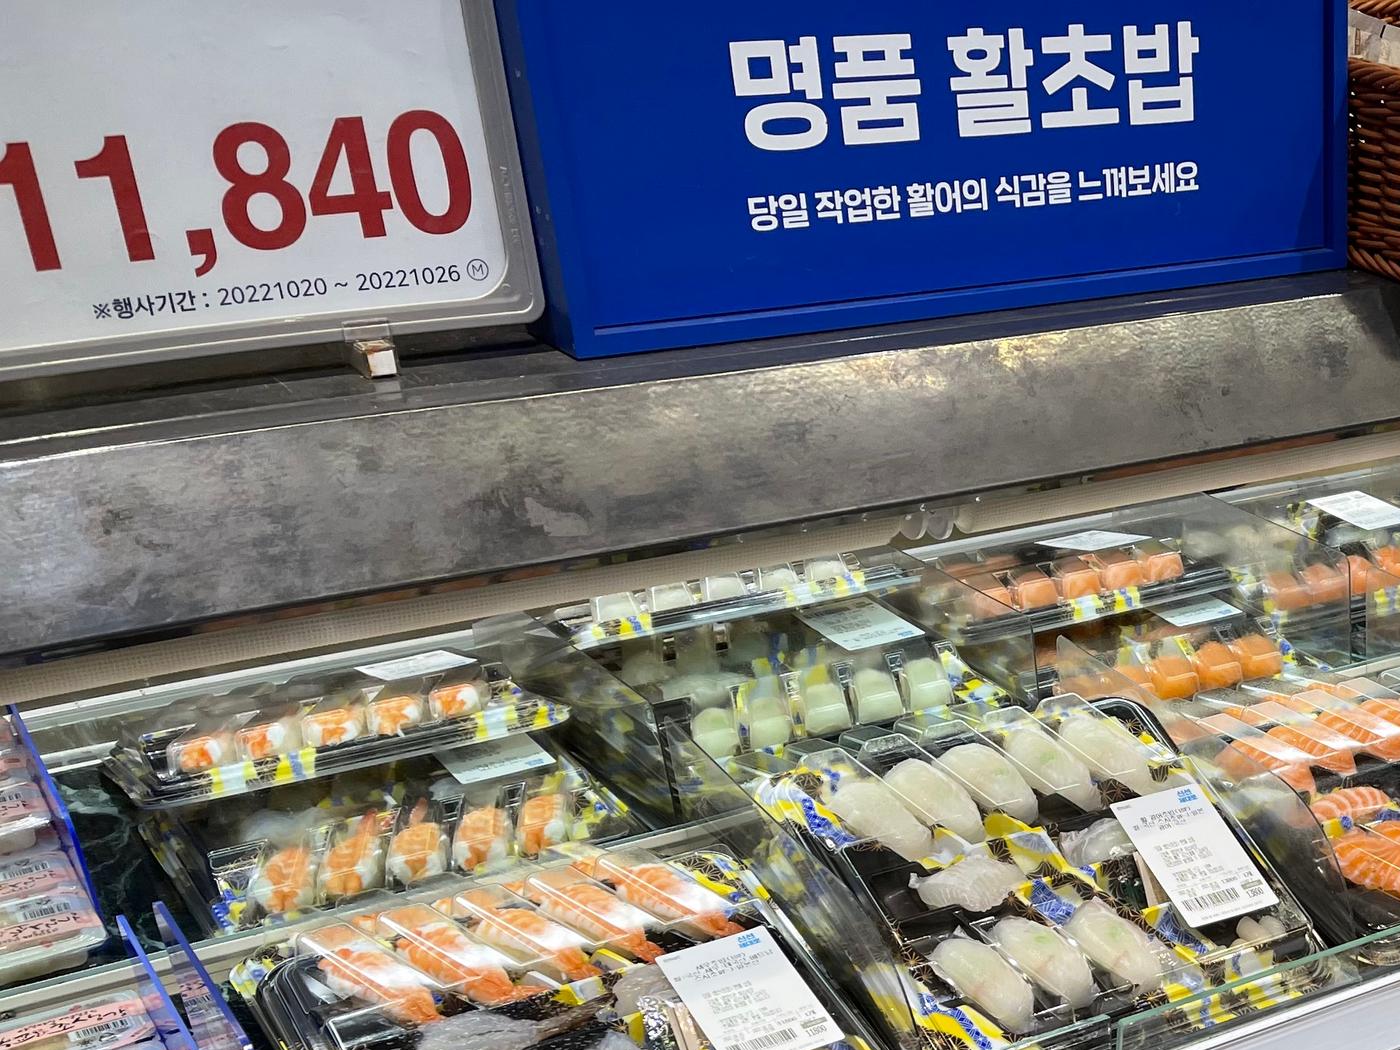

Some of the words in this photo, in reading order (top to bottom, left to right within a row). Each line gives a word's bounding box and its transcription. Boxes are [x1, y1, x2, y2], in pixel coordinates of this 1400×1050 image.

[728, 33, 921, 151] 명품
[946, 21, 1199, 138] 활초밥
[0, 109, 472, 277] 11,840
[747, 193, 809, 231] 당일
[815, 185, 901, 224] 작업한
[906, 178, 988, 213] 활어의
[995, 171, 1072, 207] 식감을
[1077, 161, 1199, 201] 느껴보세요
[218, 277, 327, 307] 20221020
[356, 264, 461, 292] 20221026
